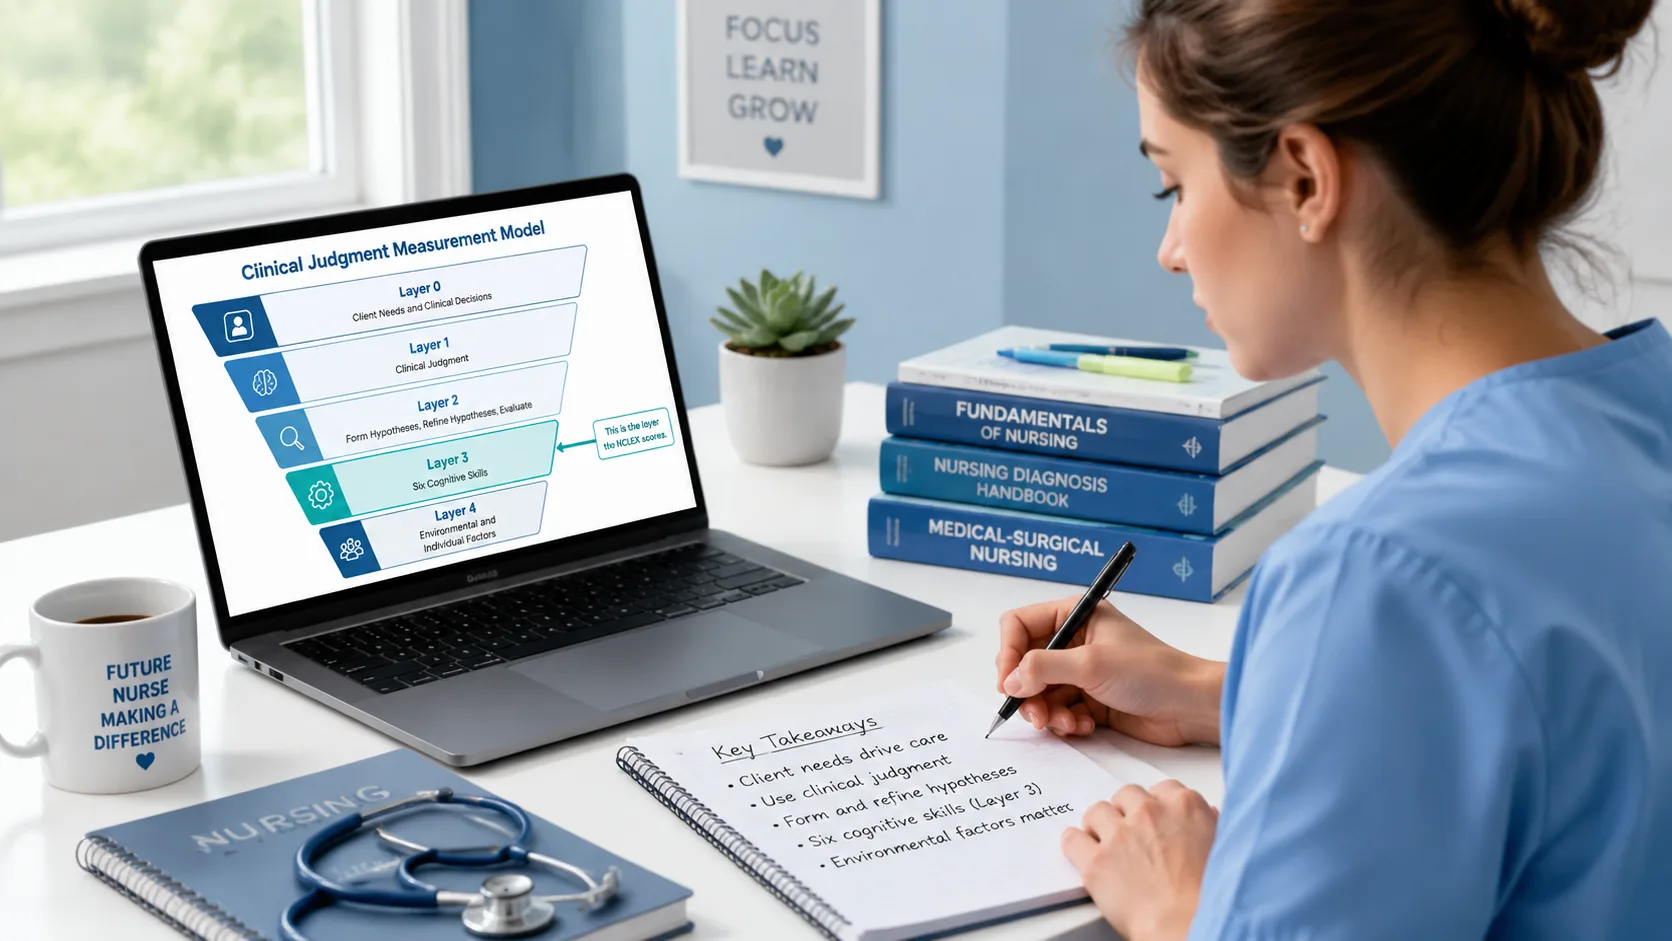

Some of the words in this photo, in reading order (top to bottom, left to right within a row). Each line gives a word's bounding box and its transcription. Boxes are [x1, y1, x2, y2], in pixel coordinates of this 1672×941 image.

[726, 15, 820, 45] FOCUS
[726, 54, 819, 84] LEARN
[727, 94, 819, 125] GROW
[308, 244, 390, 269] Judgment
[392, 228, 498, 257] Measurement
[500, 219, 545, 241] Model
[399, 284, 431, 298] Layer
[433, 280, 441, 292] 0
[352, 310, 377, 322] Client
[378, 305, 405, 318] Needs
[407, 302, 423, 313] and
[424, 297, 454, 310] Clinical
[455, 292, 492, 305] Decisions
[409, 340, 442, 354] Layer
[443, 336, 450, 348] 1
[395, 360, 426, 374] Clinical
[427, 354, 469, 368] Judgment
[417, 397, 449, 413] Layer
[451, 394, 459, 406] 2
[956, 400, 1108, 435] FUNDAMENTALS
[345, 431, 369, 444] Form
[370, 422, 422, 440] Hypotheses,
[422, 416, 449, 429] Refine
[449, 408, 499, 424] Hypotheses,
[499, 401, 533, 415] Evaluate
[604, 426, 619, 436] This
[619, 424, 627, 433] is
[627, 422, 641, 431] the
[616, 436, 641, 448] NCLEX
[980, 425, 1001, 440] OF
[1005, 428, 1079, 450] NURSING
[427, 455, 459, 470] Layer
[461, 451, 469, 463] 3
[933, 456, 1009, 481] NURSING
[1013, 467, 1108, 494] DIAGNOSIS
[412, 481, 426, 491] Six
[427, 473, 466, 487] Cognitive
[467, 468, 489, 480] Skills
[976, 482, 1069, 508] HANDBOOK
[434, 507, 466, 521] Layer
[469, 502, 477, 513] 4
[419, 519, 478, 540] Environmental
[480, 515, 496, 524] and
[928, 518, 1105, 557] MEDICAL-SURGICAL
[423, 536, 465, 553] Individual
[970, 544, 1057, 572] NURSING
[106, 654, 172, 680] FUTURE
[112, 678, 169, 704] NURSE
[101, 703, 167, 728] MAKING
[170, 699, 180, 716] A
[94, 718, 187, 750] DIFFERENCE
[711, 743, 756, 760] Key
[759, 716, 878, 749] Takeaways
[739, 766, 795, 787] Client
[800, 753, 853, 773] needs
[859, 745, 904, 761] drive
[909, 732, 949, 749] care
[760, 793, 797, 807] Use
[802, 774, 865, 798] clinical
[868, 754, 952, 786] judgment
[782, 811, 830, 828] Form
[835, 799, 869, 816] and
[872, 788, 924, 807] refine
[925, 765, 1018, 795] hypotheses
[190, 785, 391, 854] NURSING
[808, 834, 838, 848] Six
[843, 815, 919, 840] cognitive
[922, 803, 966, 822] skills
[1024, 782, 1043, 796] 3)
[830, 830, 952, 869] Environmental
[955, 816, 1016, 840] factors
